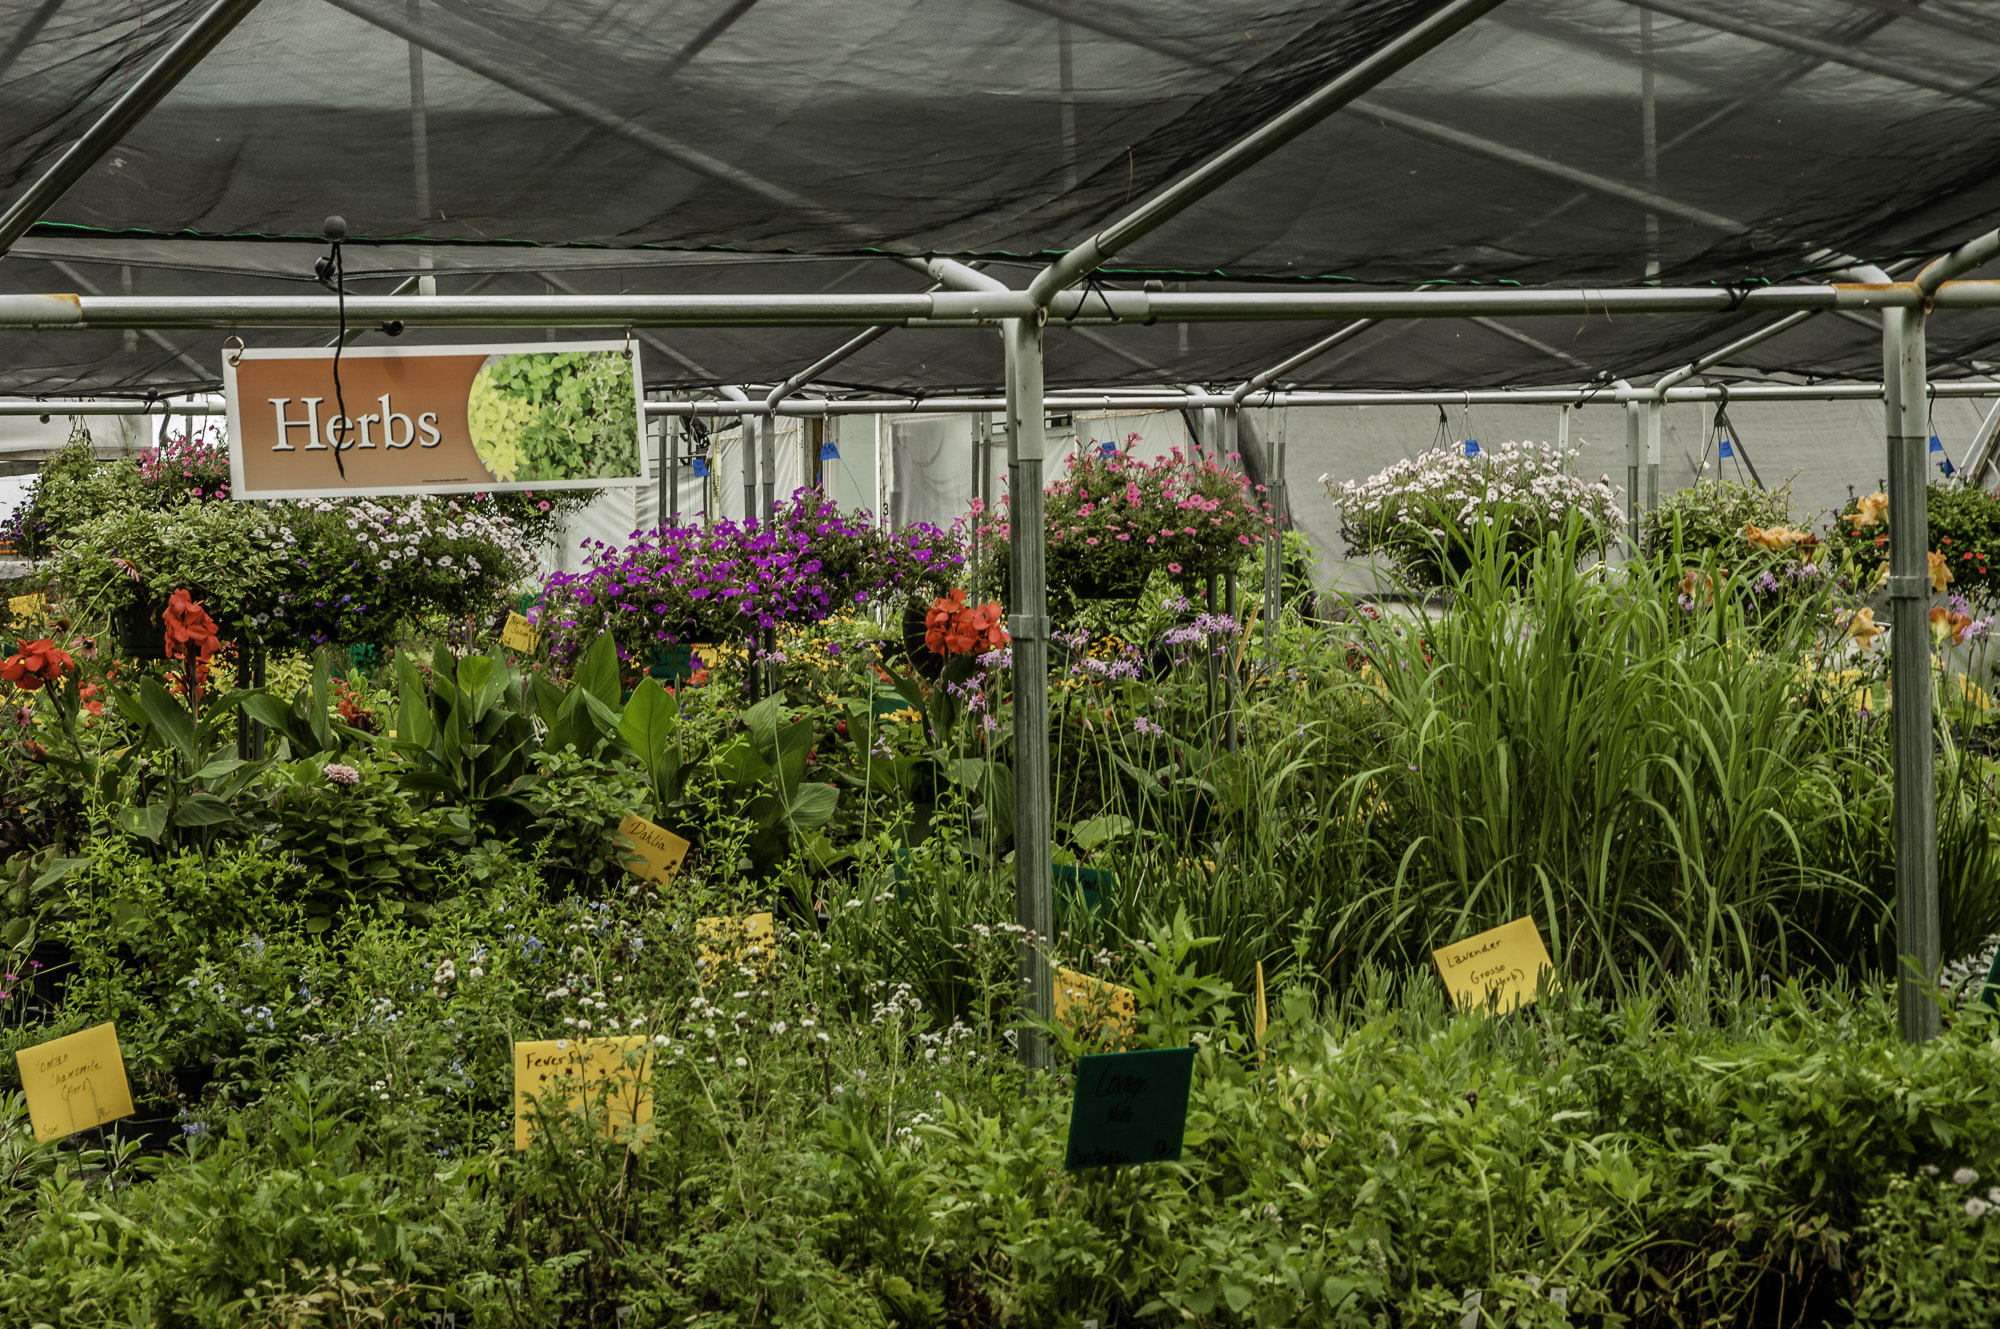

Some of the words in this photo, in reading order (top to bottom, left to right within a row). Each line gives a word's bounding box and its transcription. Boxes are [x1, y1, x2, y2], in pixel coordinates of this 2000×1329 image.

[268, 393, 443, 451] Herbs
[882, 502, 889, 516] 3
[628, 821, 666, 851] Dahlia
[1447, 940, 1502, 968] Lavender
[1470, 964, 1506, 985] Grosso
